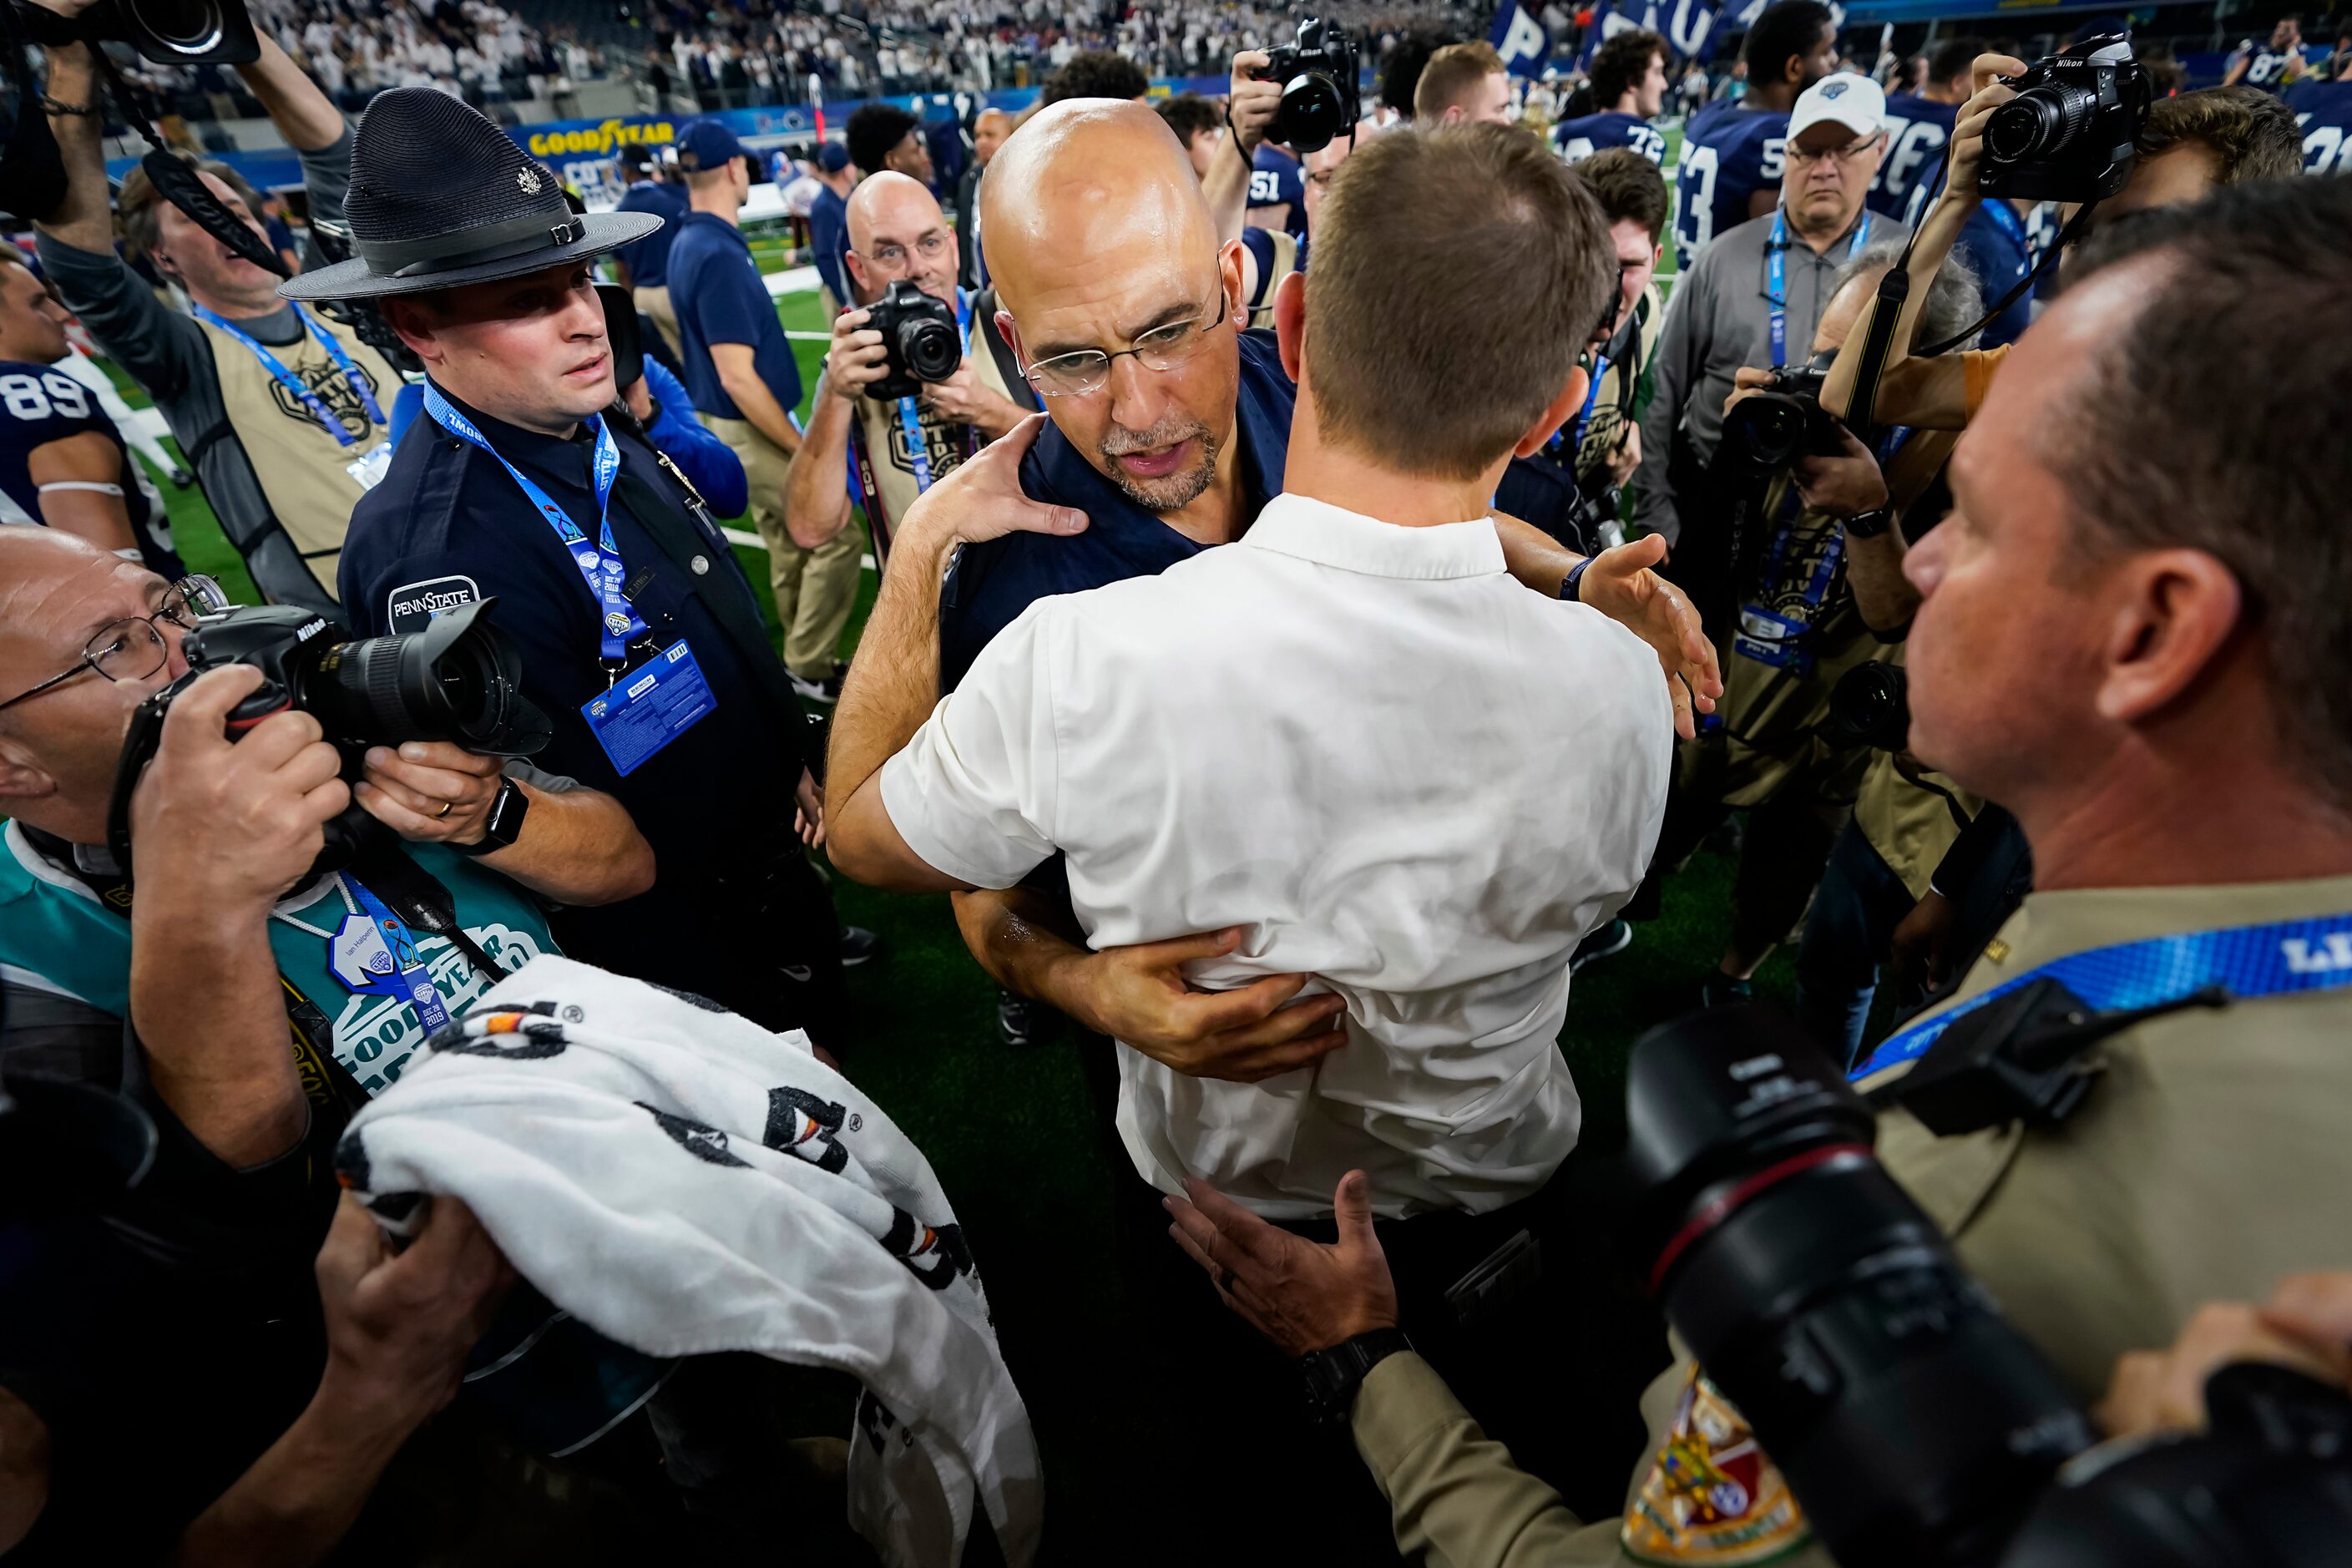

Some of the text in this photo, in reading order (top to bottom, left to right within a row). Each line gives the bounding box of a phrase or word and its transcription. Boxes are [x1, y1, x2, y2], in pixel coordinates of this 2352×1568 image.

[2056, 59, 2083, 68] Nikon
[529, 119, 675, 156] GOODYEAR
[1249, 170, 1280, 201] 51
[0, 373, 90, 421] 89
[604, 583, 620, 592] 2019
[296, 618, 326, 642] Nikon
[346, 925, 375, 957] Ian Halperin
[422, 1004, 441, 1016] DEC 28
[425, 1011, 444, 1027] 2019
